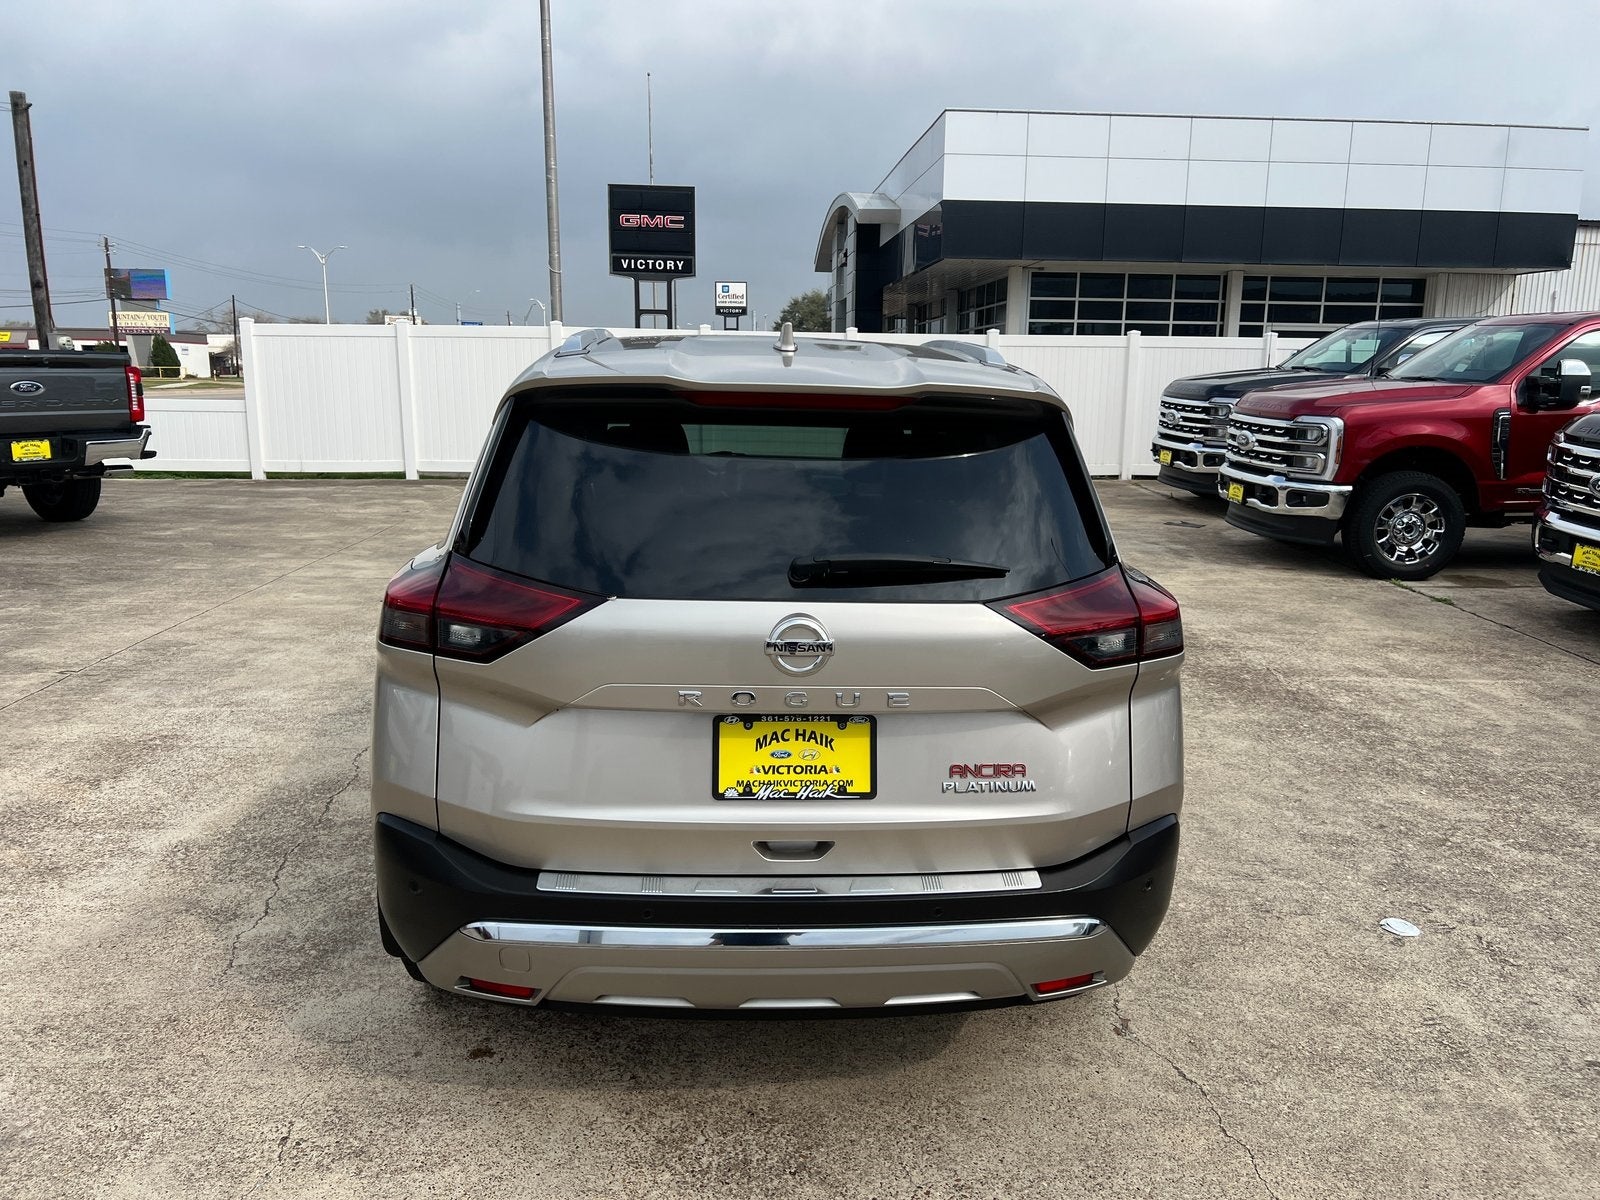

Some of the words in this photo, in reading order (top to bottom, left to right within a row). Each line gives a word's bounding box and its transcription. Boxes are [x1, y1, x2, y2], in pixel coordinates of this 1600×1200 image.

[620, 214, 684, 228] GMC
[621, 259, 684, 270] VICTORY
[773, 643, 827, 653] NISSAN
[678, 690, 910, 709] ROGUE
[755, 728, 790, 752] MAC
[794, 728, 835, 752] HAIK
[772, 750, 790, 758] Ford
[761, 764, 829, 775] VICTORIA
[949, 763, 1027, 778] ANCIRA
[736, 779, 854, 788] MACHAIKVICTORIA.COM
[942, 780, 1036, 793] PLATINUM
[755, 784, 795, 800] Mac
[795, 784, 840, 800] Haik
